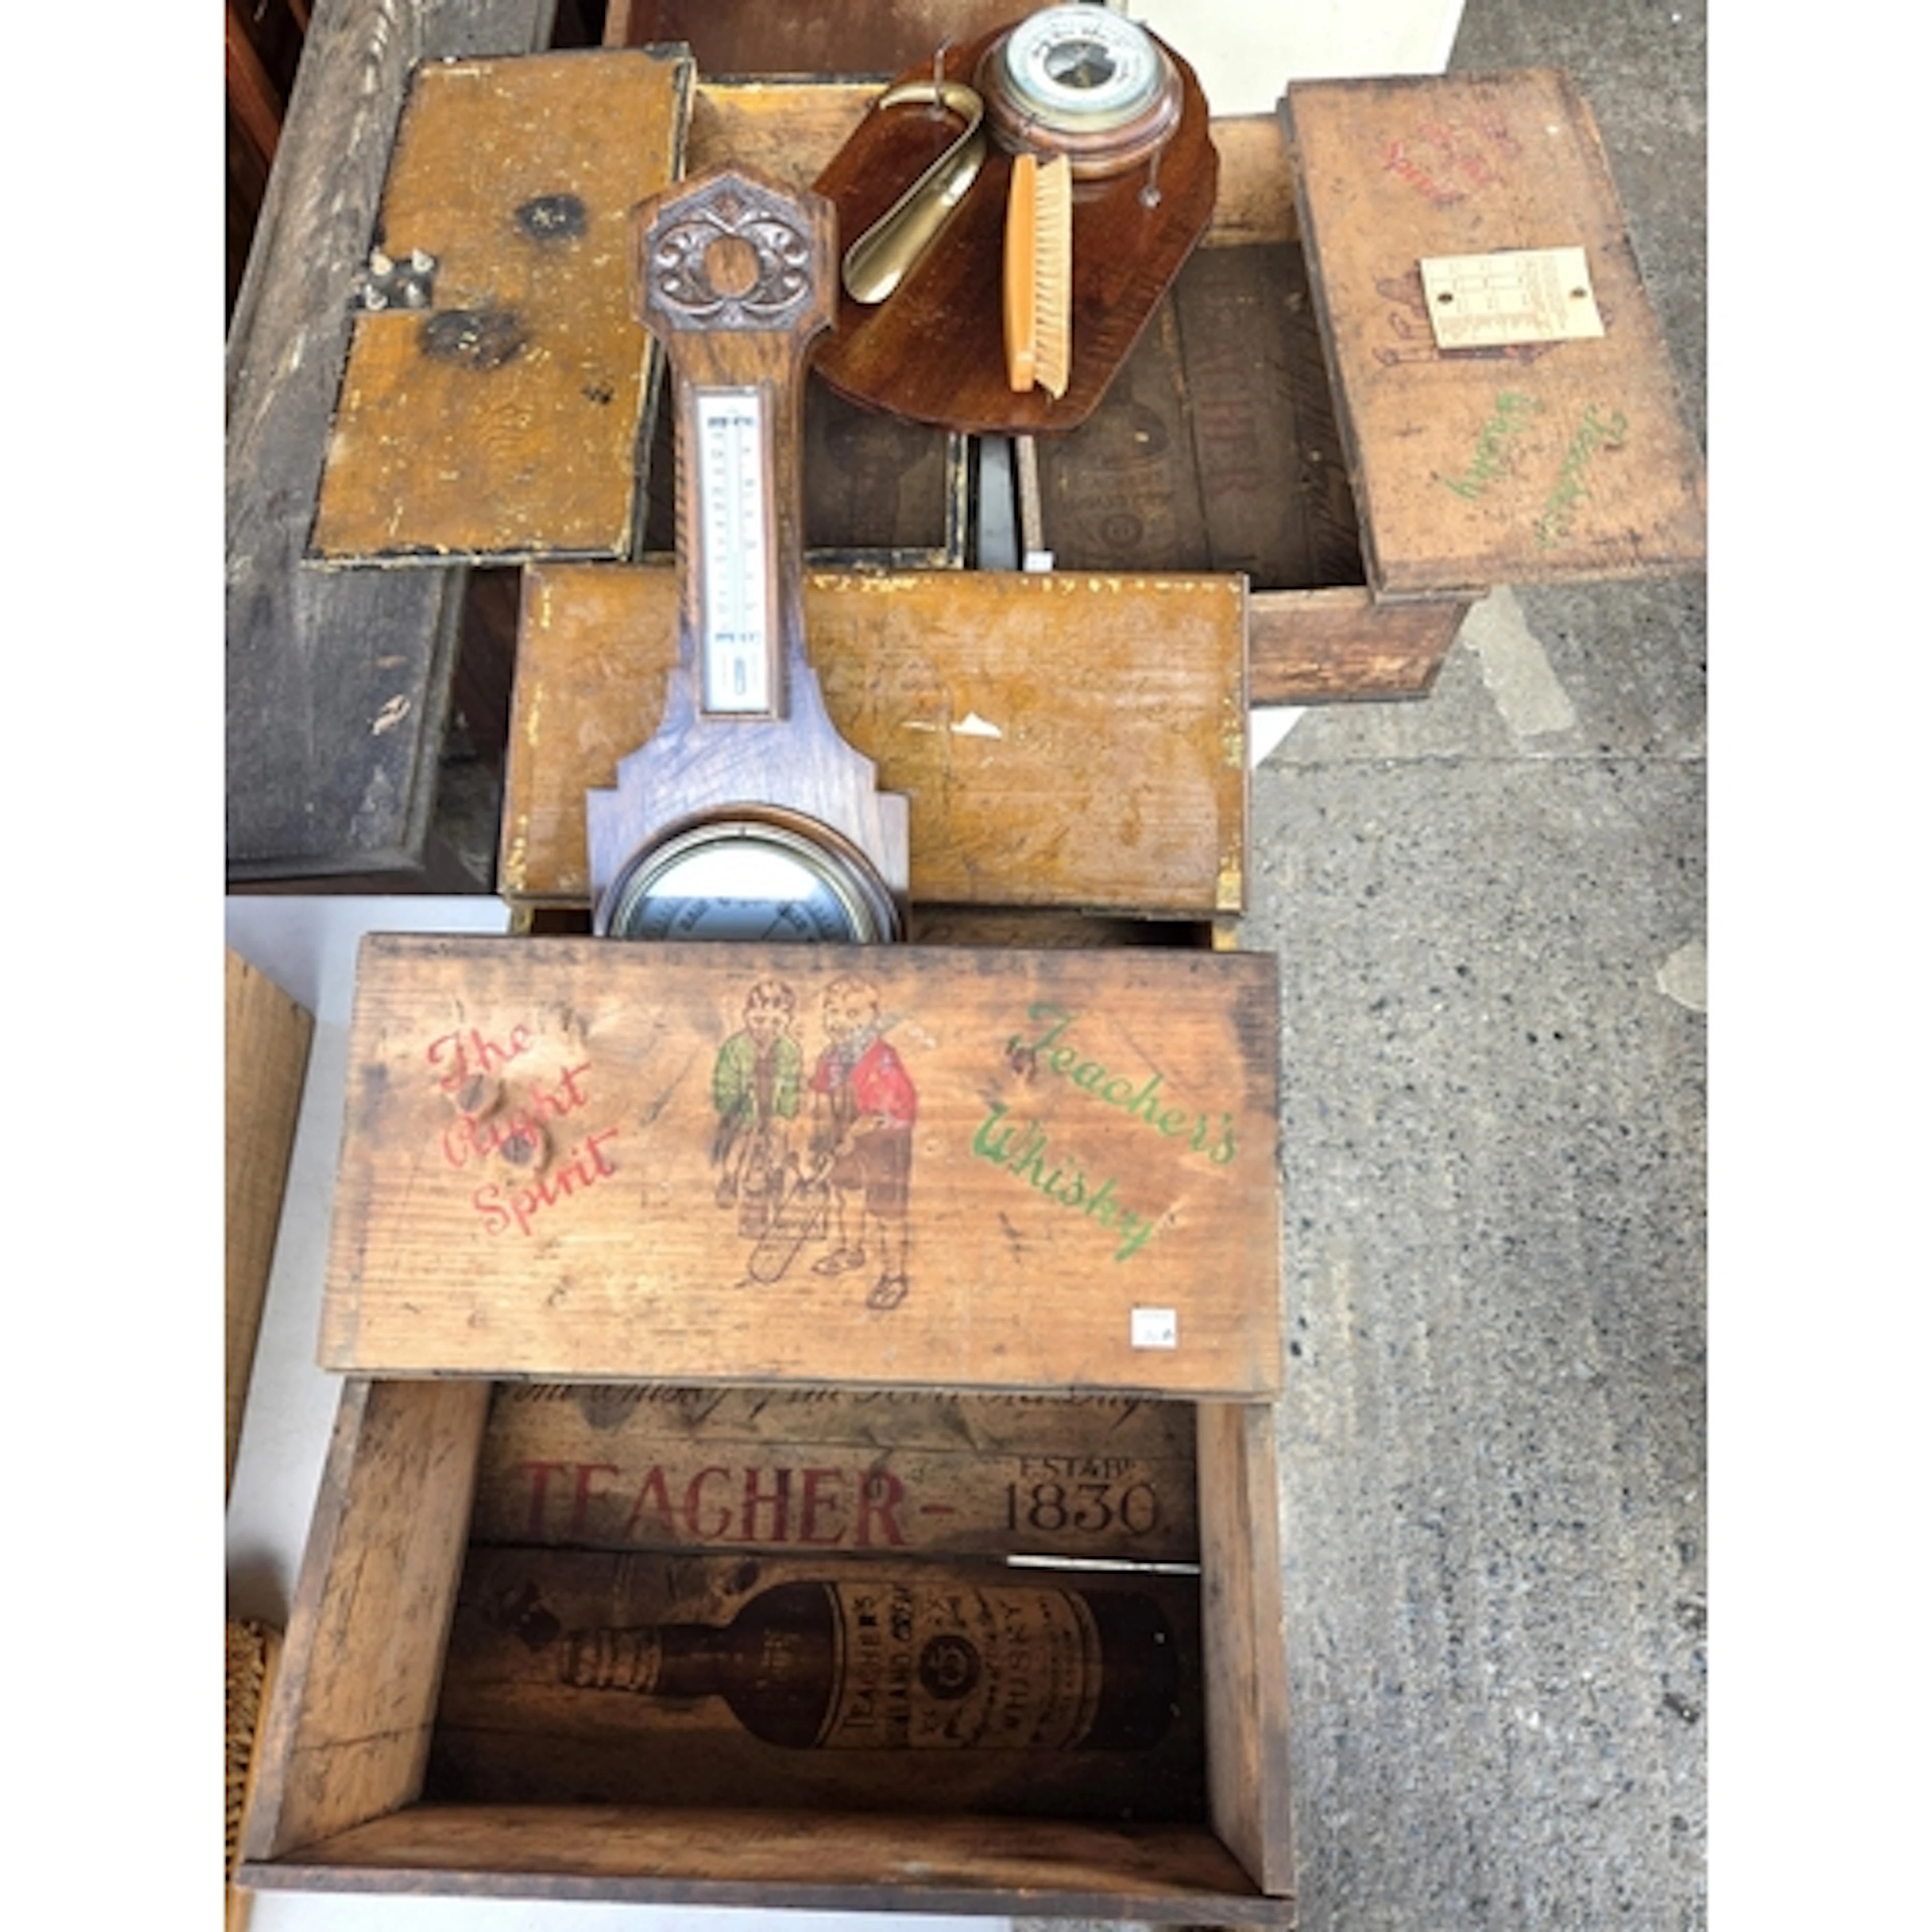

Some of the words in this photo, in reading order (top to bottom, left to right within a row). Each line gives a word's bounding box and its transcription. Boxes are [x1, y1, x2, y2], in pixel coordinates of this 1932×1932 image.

[426, 1024, 532, 1092] The
[1006, 1001, 1238, 1165] Teacher's
[471, 1127, 619, 1237] Spirit
[972, 1098, 1155, 1261] Whisky
